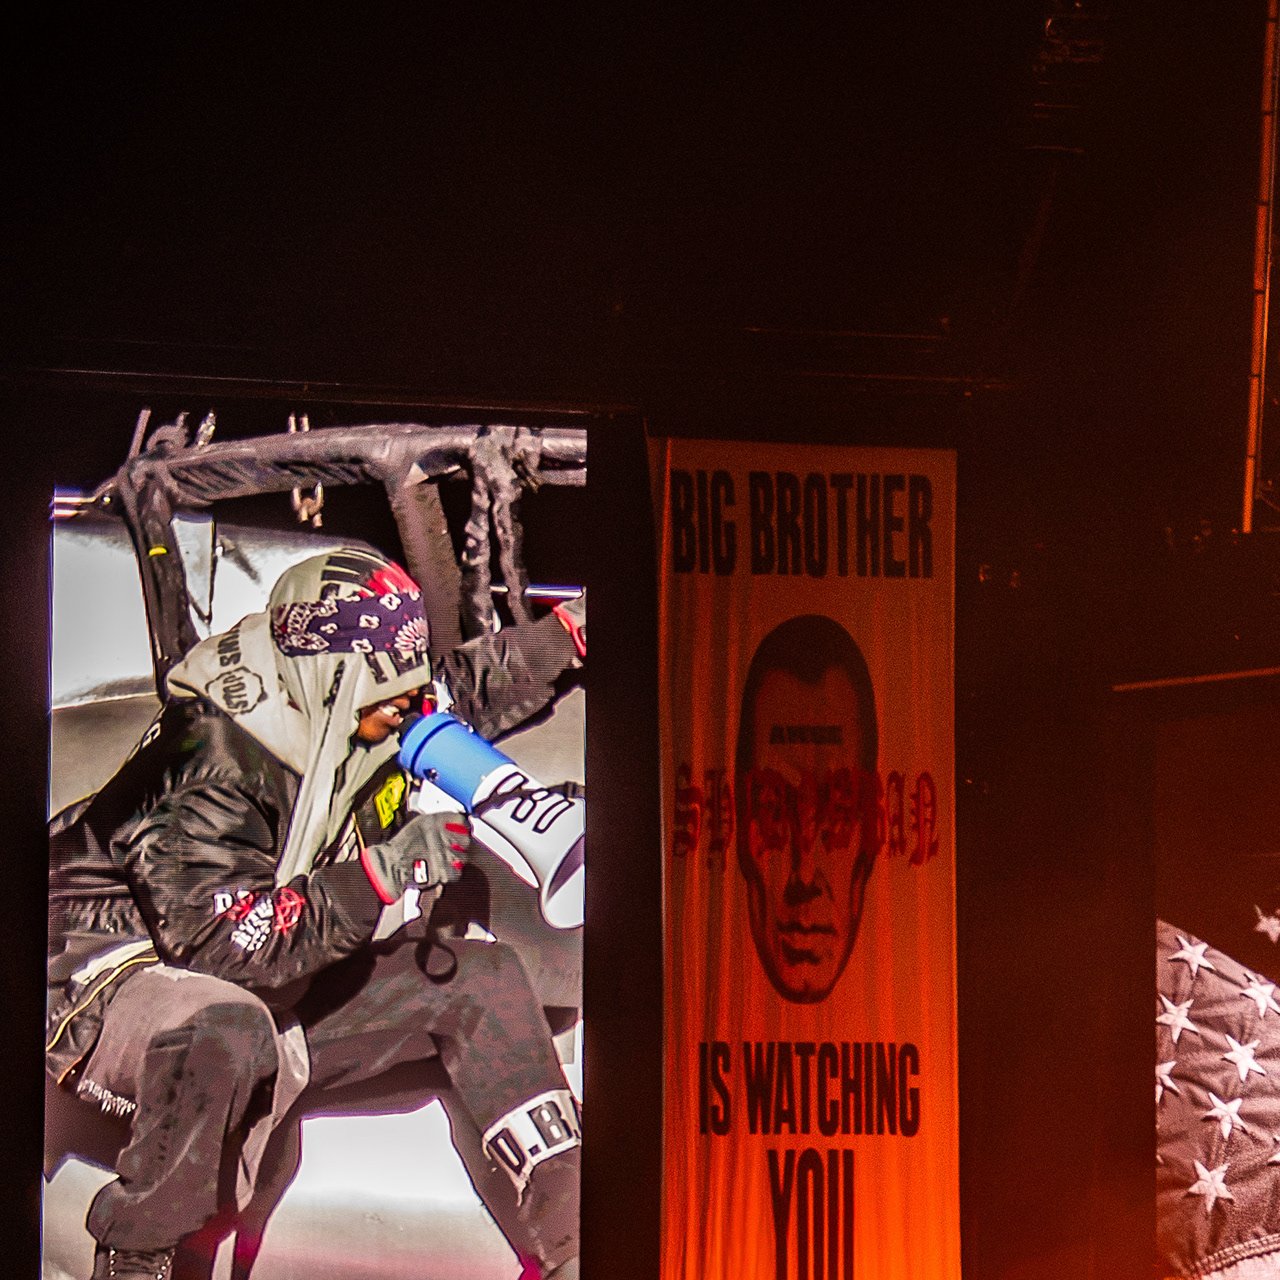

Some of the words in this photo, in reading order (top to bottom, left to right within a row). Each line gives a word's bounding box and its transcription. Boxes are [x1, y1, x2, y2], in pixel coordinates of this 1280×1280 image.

[670, 469, 736, 566] BIG
[749, 470, 933, 578] BROTHER
[222, 672, 248, 711] STOP
[699, 1041, 732, 1136] IS
[743, 1041, 921, 1138] WATCHING
